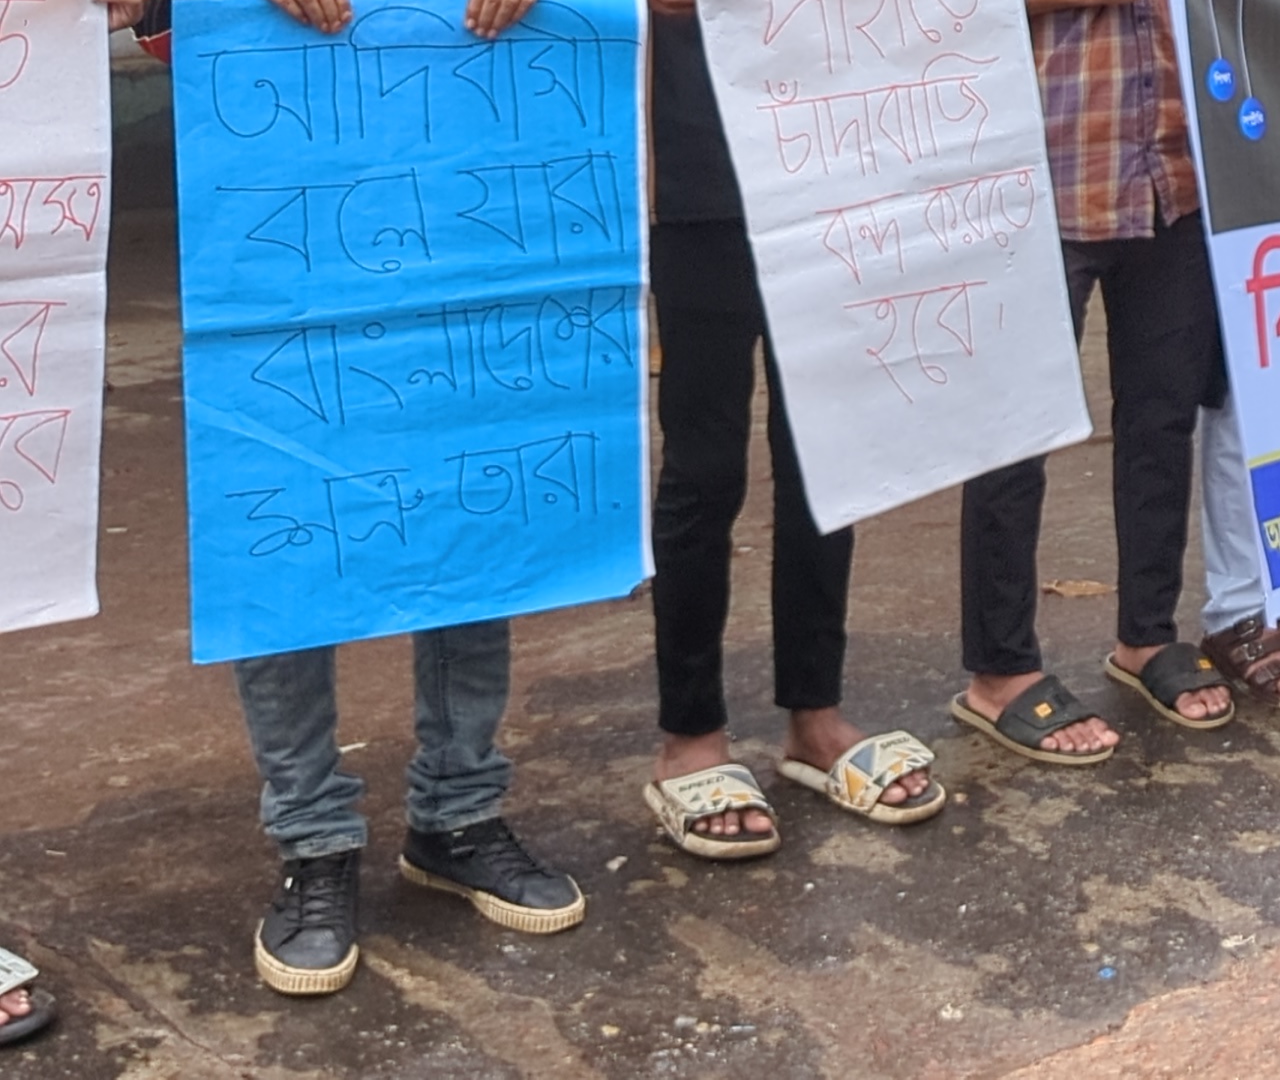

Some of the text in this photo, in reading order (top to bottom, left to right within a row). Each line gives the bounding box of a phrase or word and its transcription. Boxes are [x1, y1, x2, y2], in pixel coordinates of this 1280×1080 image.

[216, 149, 624, 273] বলে যারা
[919, 167, 1036, 255] করতে
[843, 280, 989, 404] হবে
